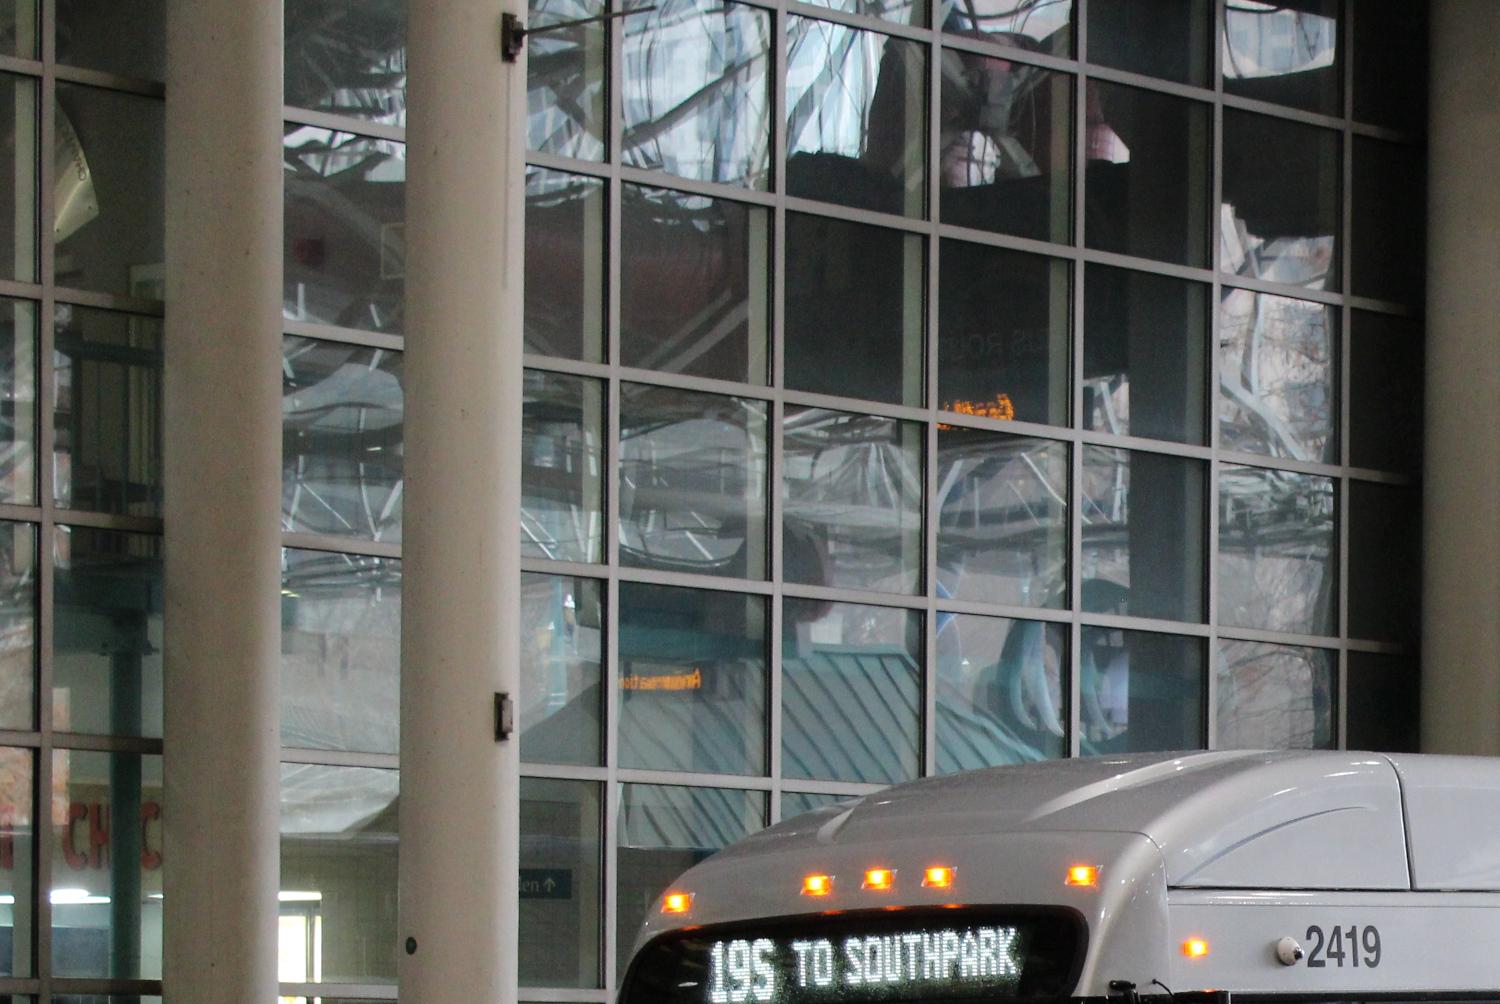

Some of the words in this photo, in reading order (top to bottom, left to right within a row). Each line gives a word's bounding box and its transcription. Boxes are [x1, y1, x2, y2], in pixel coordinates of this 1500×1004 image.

[792, 940, 832, 987] TO
[844, 927, 1018, 984] SOUTHPARK
[1305, 924, 1382, 969] 2419
